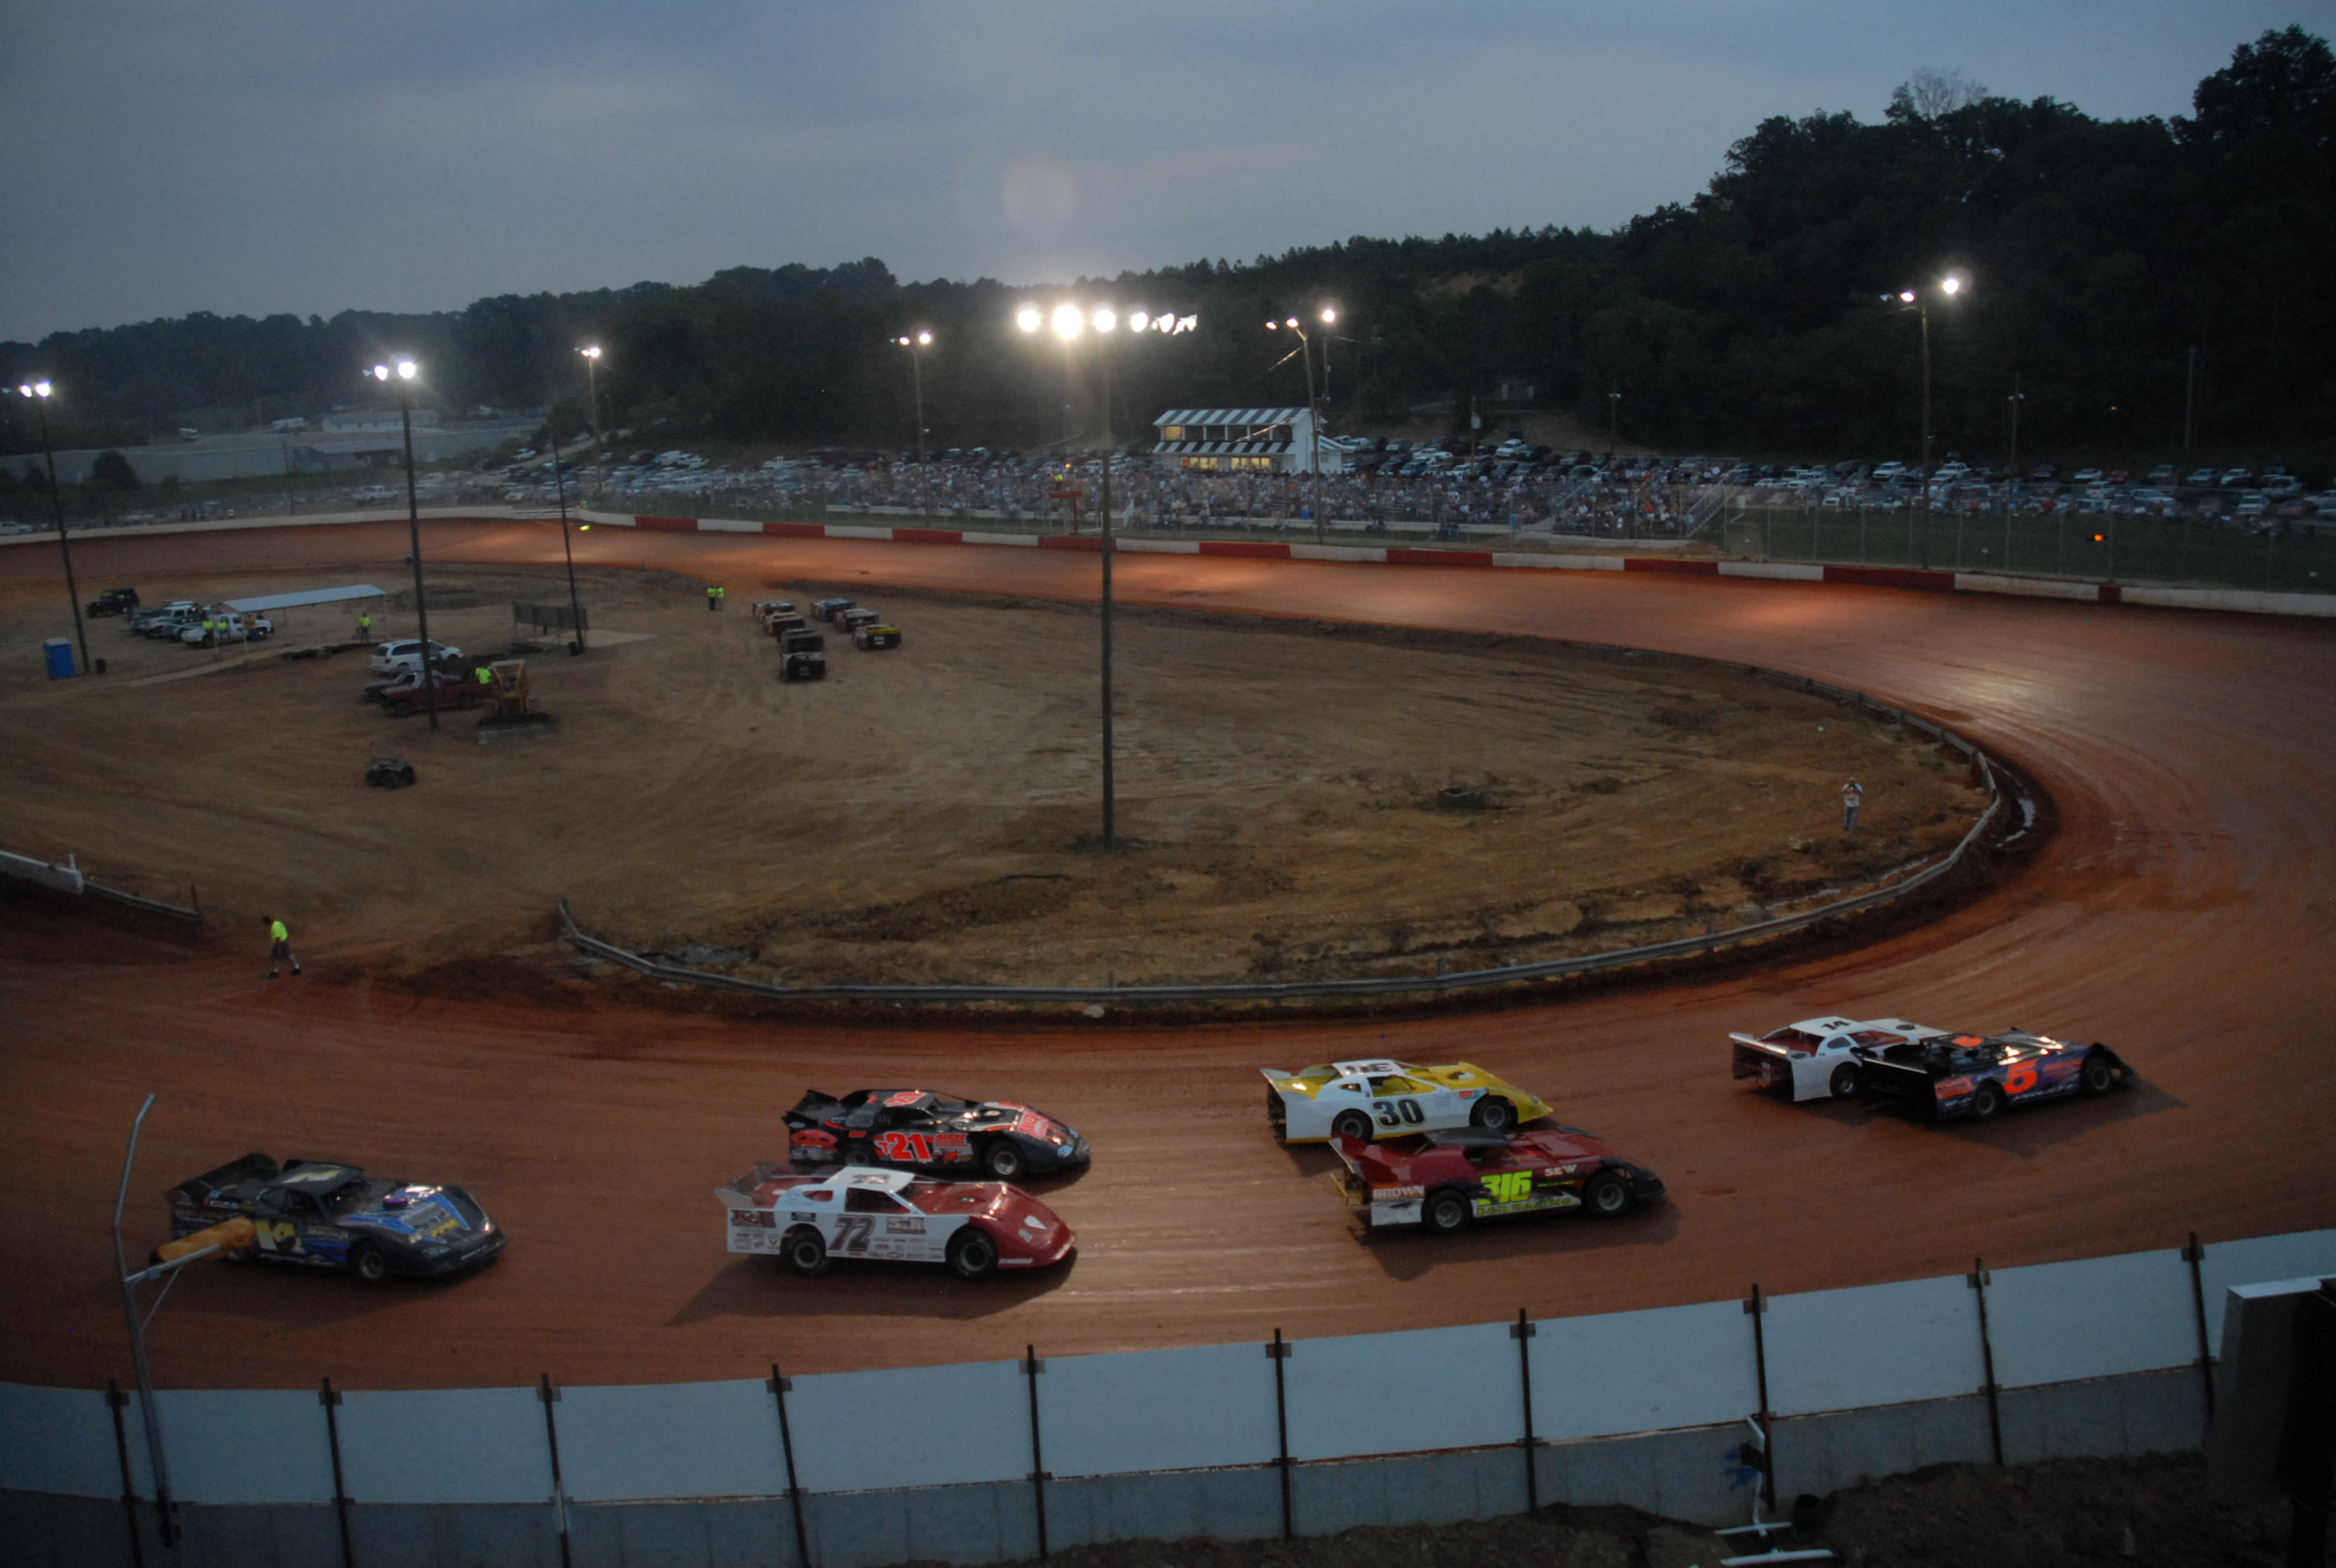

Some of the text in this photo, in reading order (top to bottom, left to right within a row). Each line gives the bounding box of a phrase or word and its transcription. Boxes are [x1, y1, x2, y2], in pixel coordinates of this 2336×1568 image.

[2002, 1060, 2038, 1094] 5
[1372, 1099, 1425, 1127] 30
[1372, 1185, 1425, 1198] BROWN
[1478, 1170, 1533, 1206] 316
[827, 1214, 876, 1253] 72
